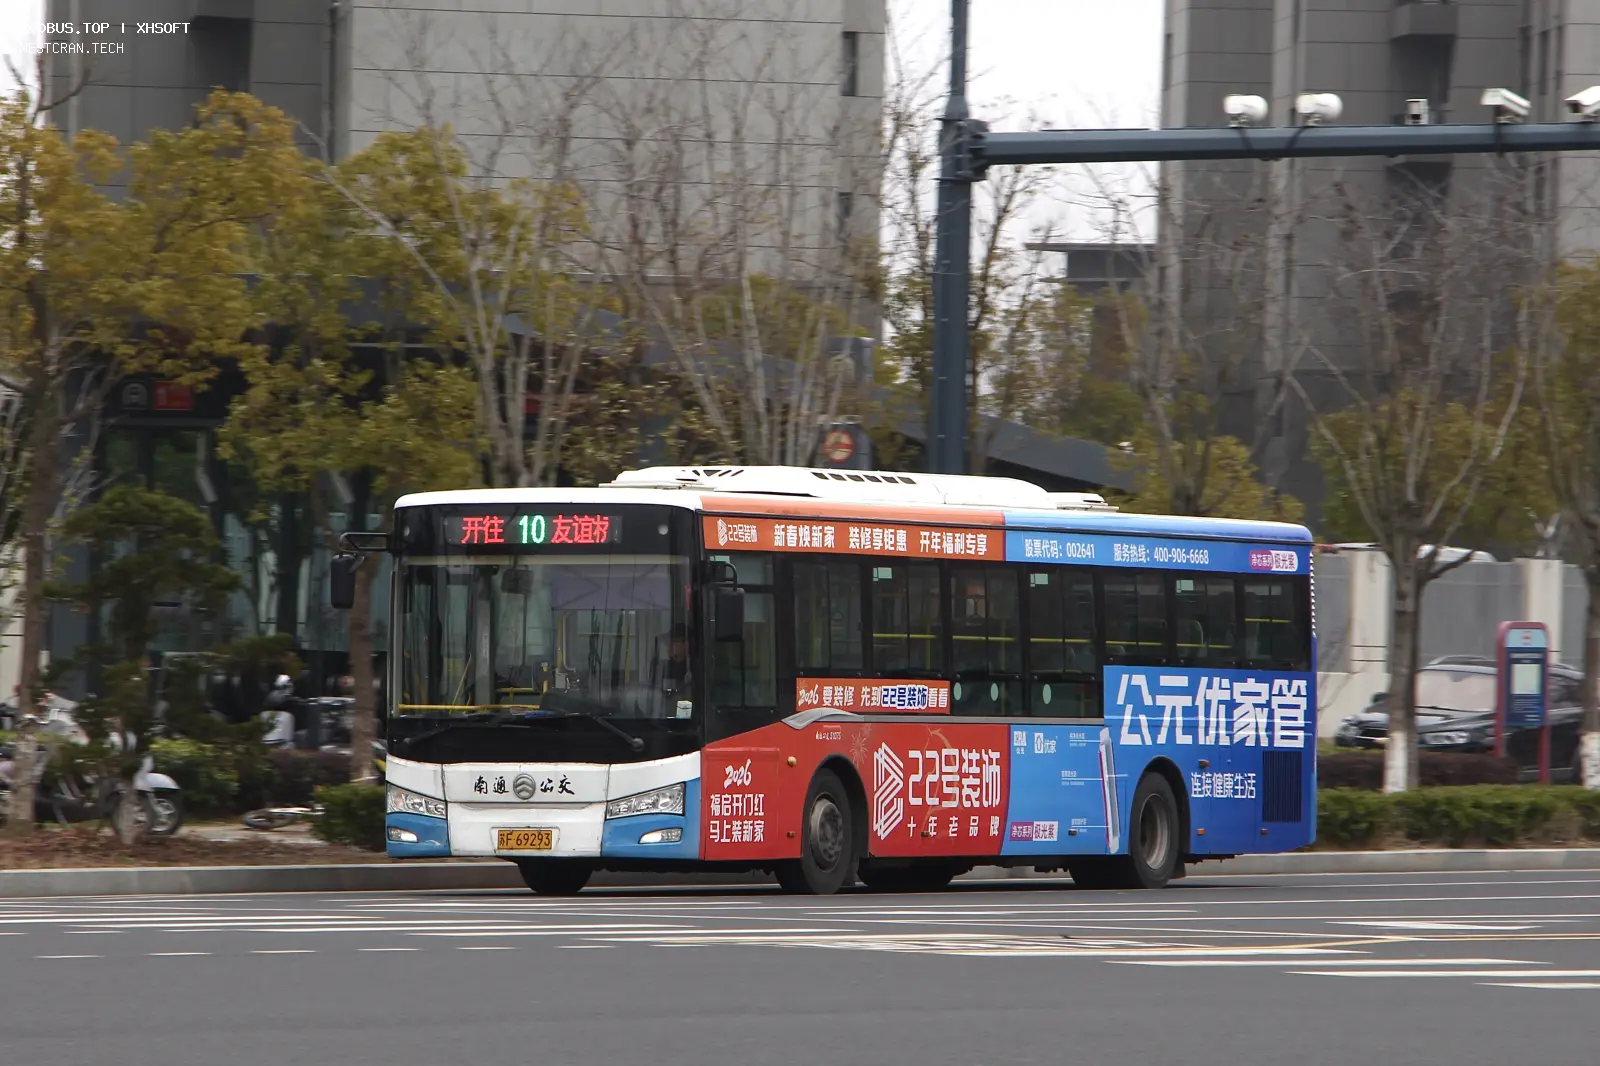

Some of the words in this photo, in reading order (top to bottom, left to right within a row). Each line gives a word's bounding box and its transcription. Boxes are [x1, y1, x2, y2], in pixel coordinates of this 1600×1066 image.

[461, 515, 505, 544] 开往
[519, 515, 546, 544] 10
[727, 523, 758, 543] 22号装饰
[773, 524, 835, 549] 新春焕新家
[848, 526, 908, 552] 装修享钜惠
[919, 531, 988, 556] 开年福利专享
[798, 684, 819, 707] 2026
[822, 686, 855, 707] 要装修
[1116, 673, 1308, 748] 公元优家管
[473, 775, 509, 795] 南通
[540, 774, 576, 795] 公交
[723, 758, 752, 789] 2026
[908, 748, 1001, 808] 22号装饰
[1190, 771, 1256, 799] 连接健康生活
[710, 793, 765, 816] 福启开门红
[709, 819, 765, 843] 马上装新家
